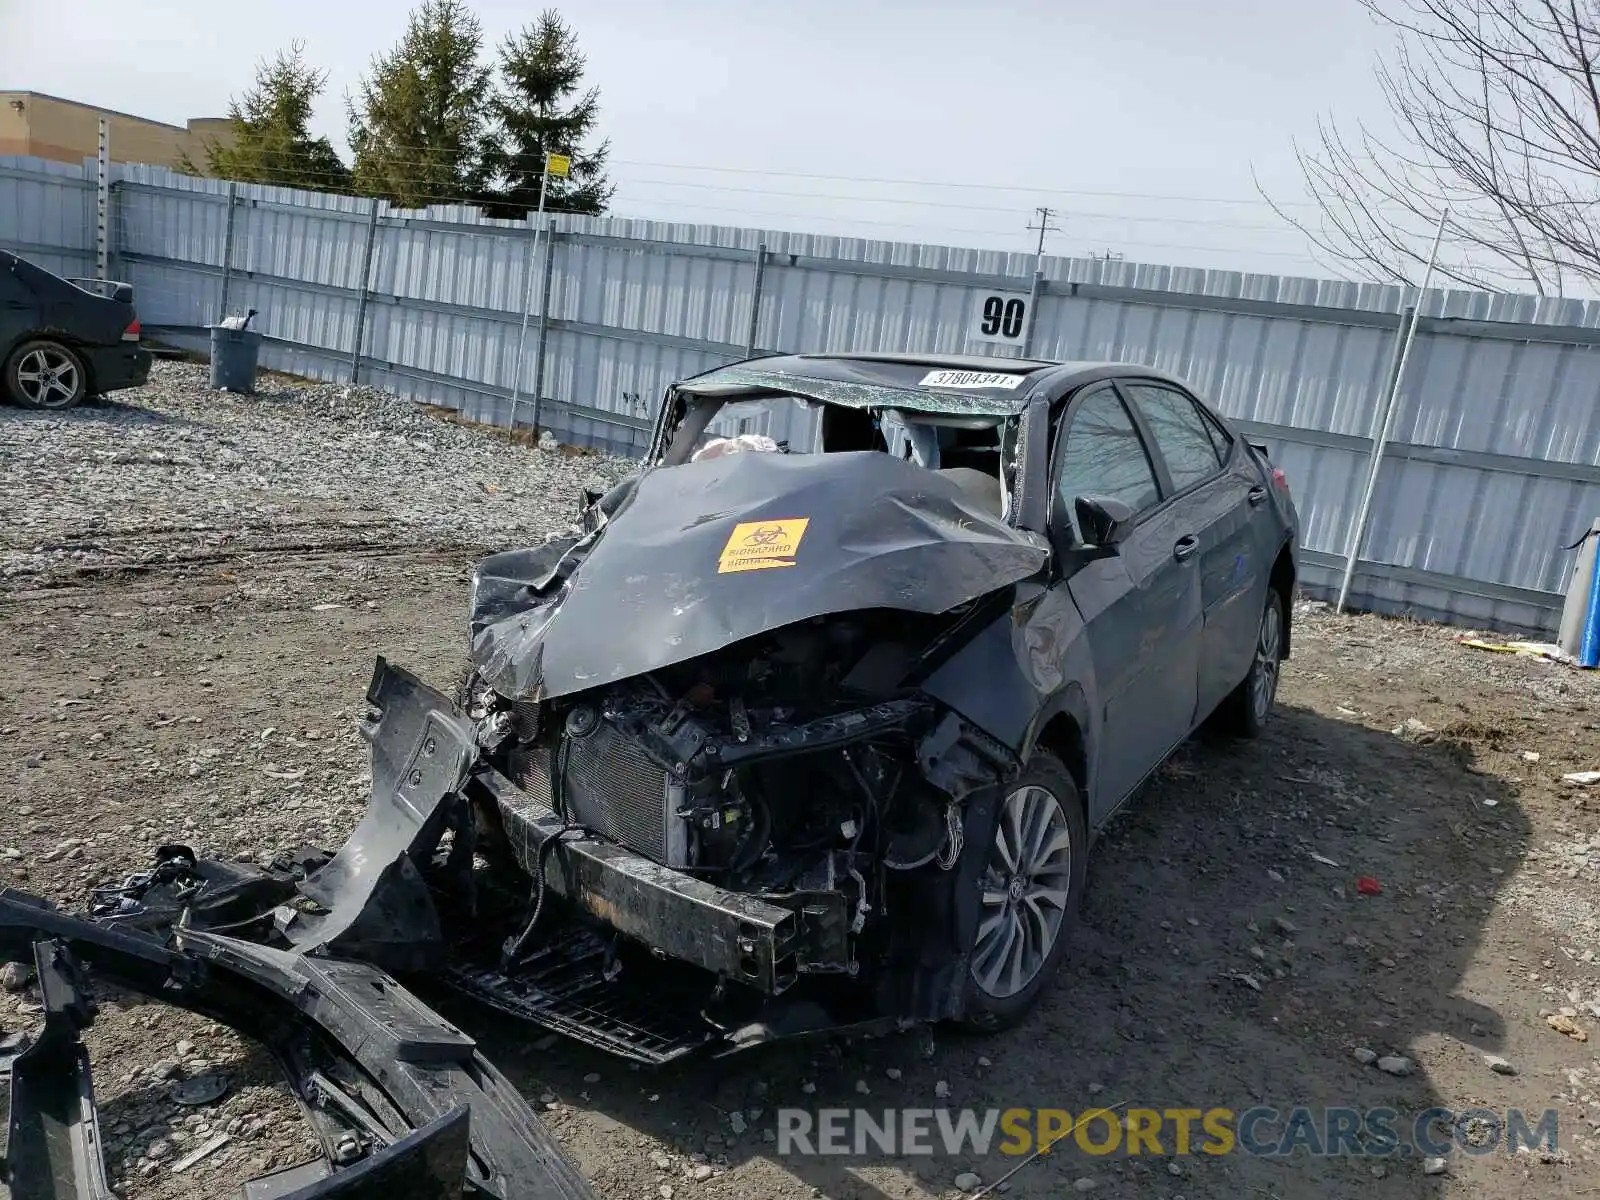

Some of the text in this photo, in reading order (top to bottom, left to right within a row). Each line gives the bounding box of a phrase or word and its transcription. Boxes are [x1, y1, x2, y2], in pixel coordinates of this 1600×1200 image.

[981, 296, 1025, 338] 90
[934, 372, 1008, 385] 37804341
[728, 545, 791, 556] BIOHAZARD
